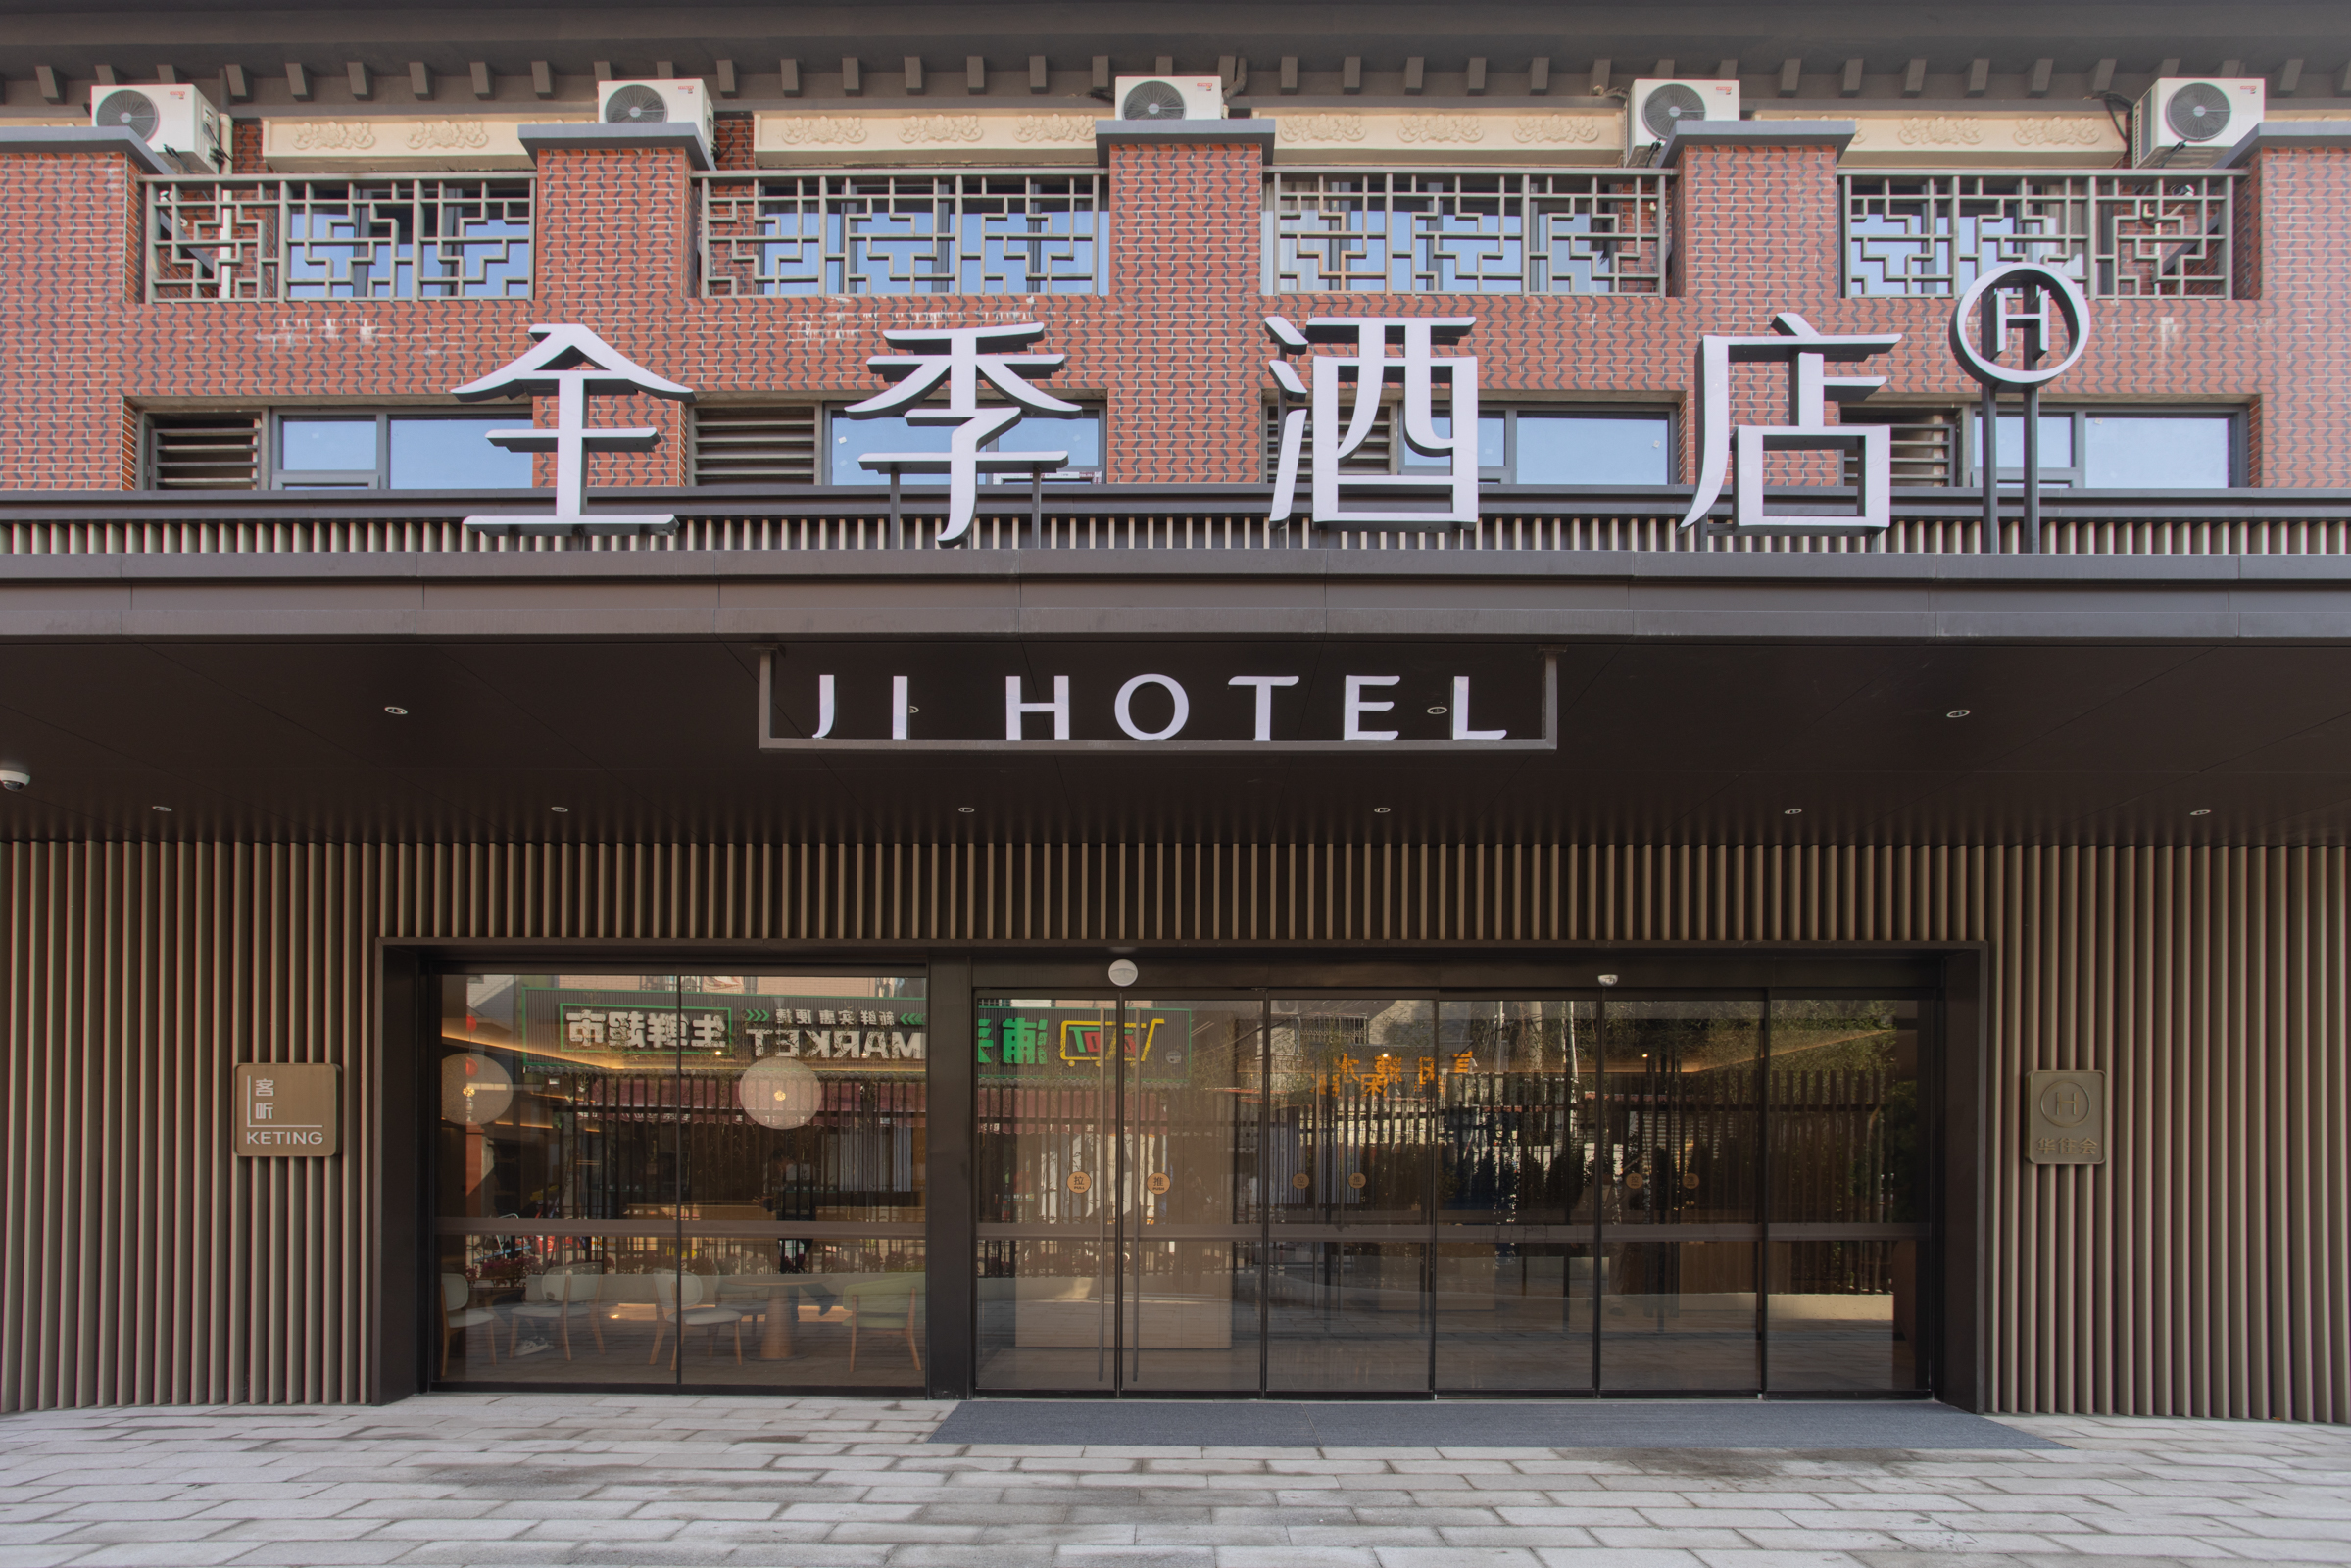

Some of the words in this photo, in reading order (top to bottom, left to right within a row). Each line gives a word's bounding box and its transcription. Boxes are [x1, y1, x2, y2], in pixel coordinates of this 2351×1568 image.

[1993, 286, 2049, 357] H
[450, 313, 1902, 547] 全季酒店
[812, 674, 908, 740] JI
[1005, 673, 1507, 741] HOTEL
[255, 1078, 274, 1119] 客听
[247, 1131, 323, 1145] KETING
[2036, 1137, 2097, 1155] 华住会
[1073, 1176, 1085, 1185] 拉
[1153, 1177, 1164, 1186] 推
